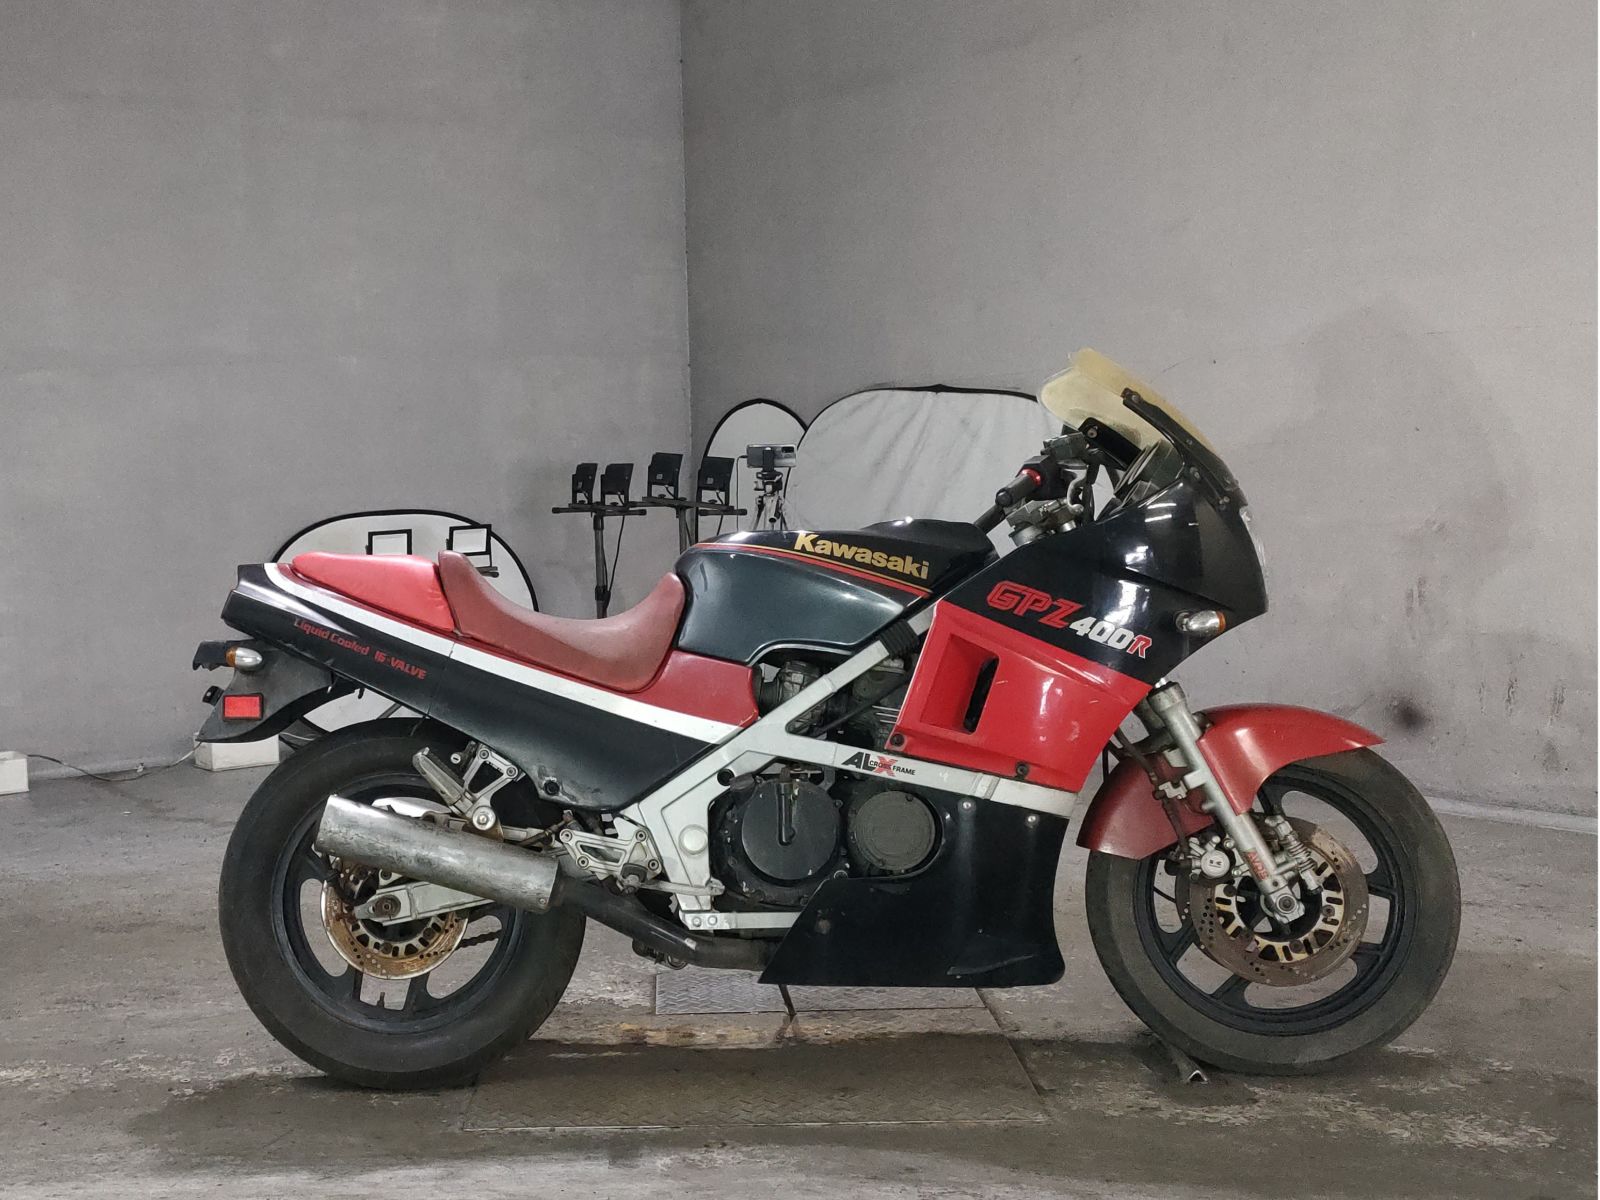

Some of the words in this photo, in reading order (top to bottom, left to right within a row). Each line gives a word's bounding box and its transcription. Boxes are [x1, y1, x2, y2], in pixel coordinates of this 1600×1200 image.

[794, 532, 929, 580] Kawasaki
[986, 580, 1084, 630] GPZ
[293, 618, 331, 640] Liquid
[329, 633, 370, 655] Cooled
[892, 765, 916, 776] FRAME
